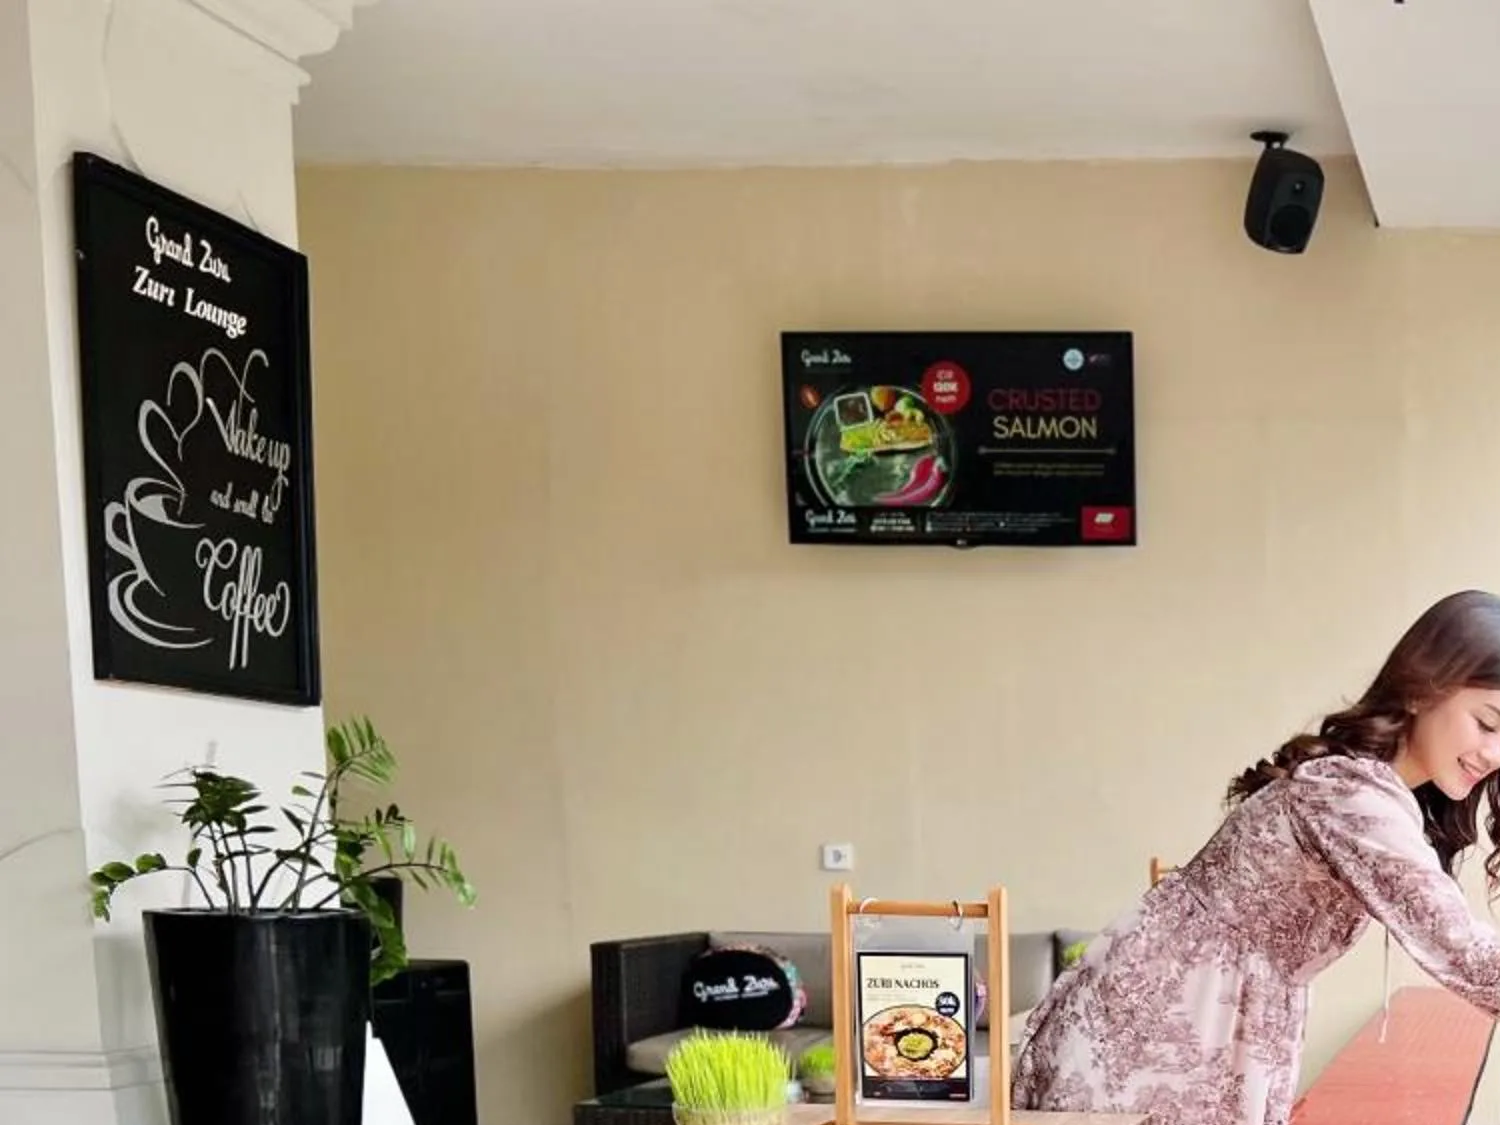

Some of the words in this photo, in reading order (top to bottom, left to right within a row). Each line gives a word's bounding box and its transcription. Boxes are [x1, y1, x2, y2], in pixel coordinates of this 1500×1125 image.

[145, 215, 195, 266] Grand
[184, 286, 248, 340] Lounge
[987, 387, 1102, 412] CRUSTED
[992, 415, 1098, 439] SALMON
[196, 538, 291, 670] Coffee
[894, 978, 940, 990] NACHOS
